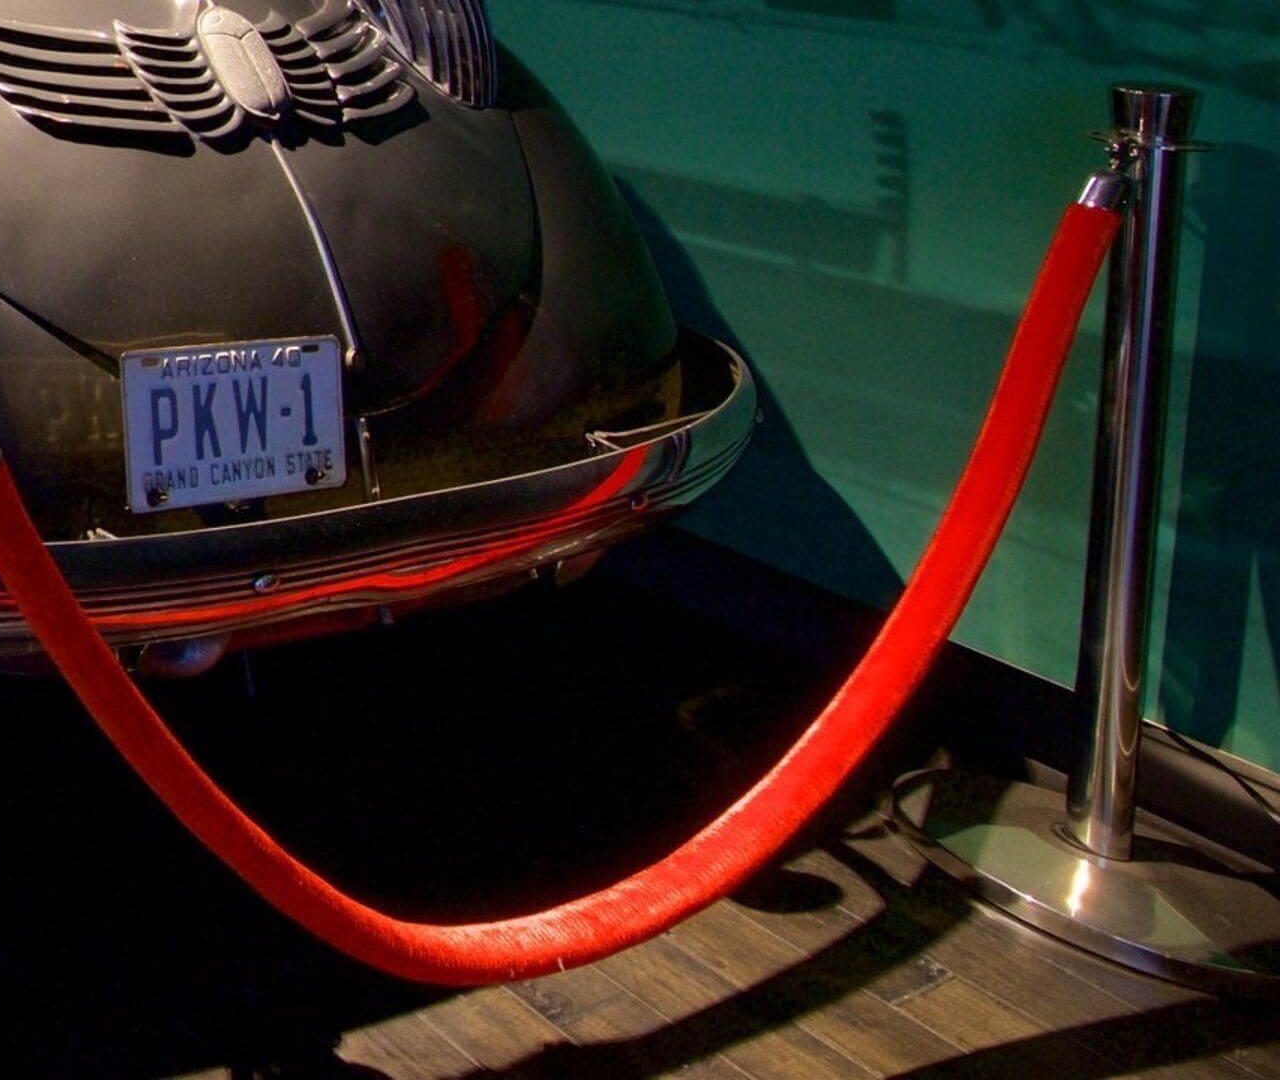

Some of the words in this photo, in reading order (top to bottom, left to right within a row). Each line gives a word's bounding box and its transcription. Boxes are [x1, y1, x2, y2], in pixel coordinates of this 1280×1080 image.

[161, 349, 264, 380] ARIZONA
[149, 372, 318, 466] PKW-1
[210, 457, 276, 486] CANYON
[286, 449, 334, 476] STATE
